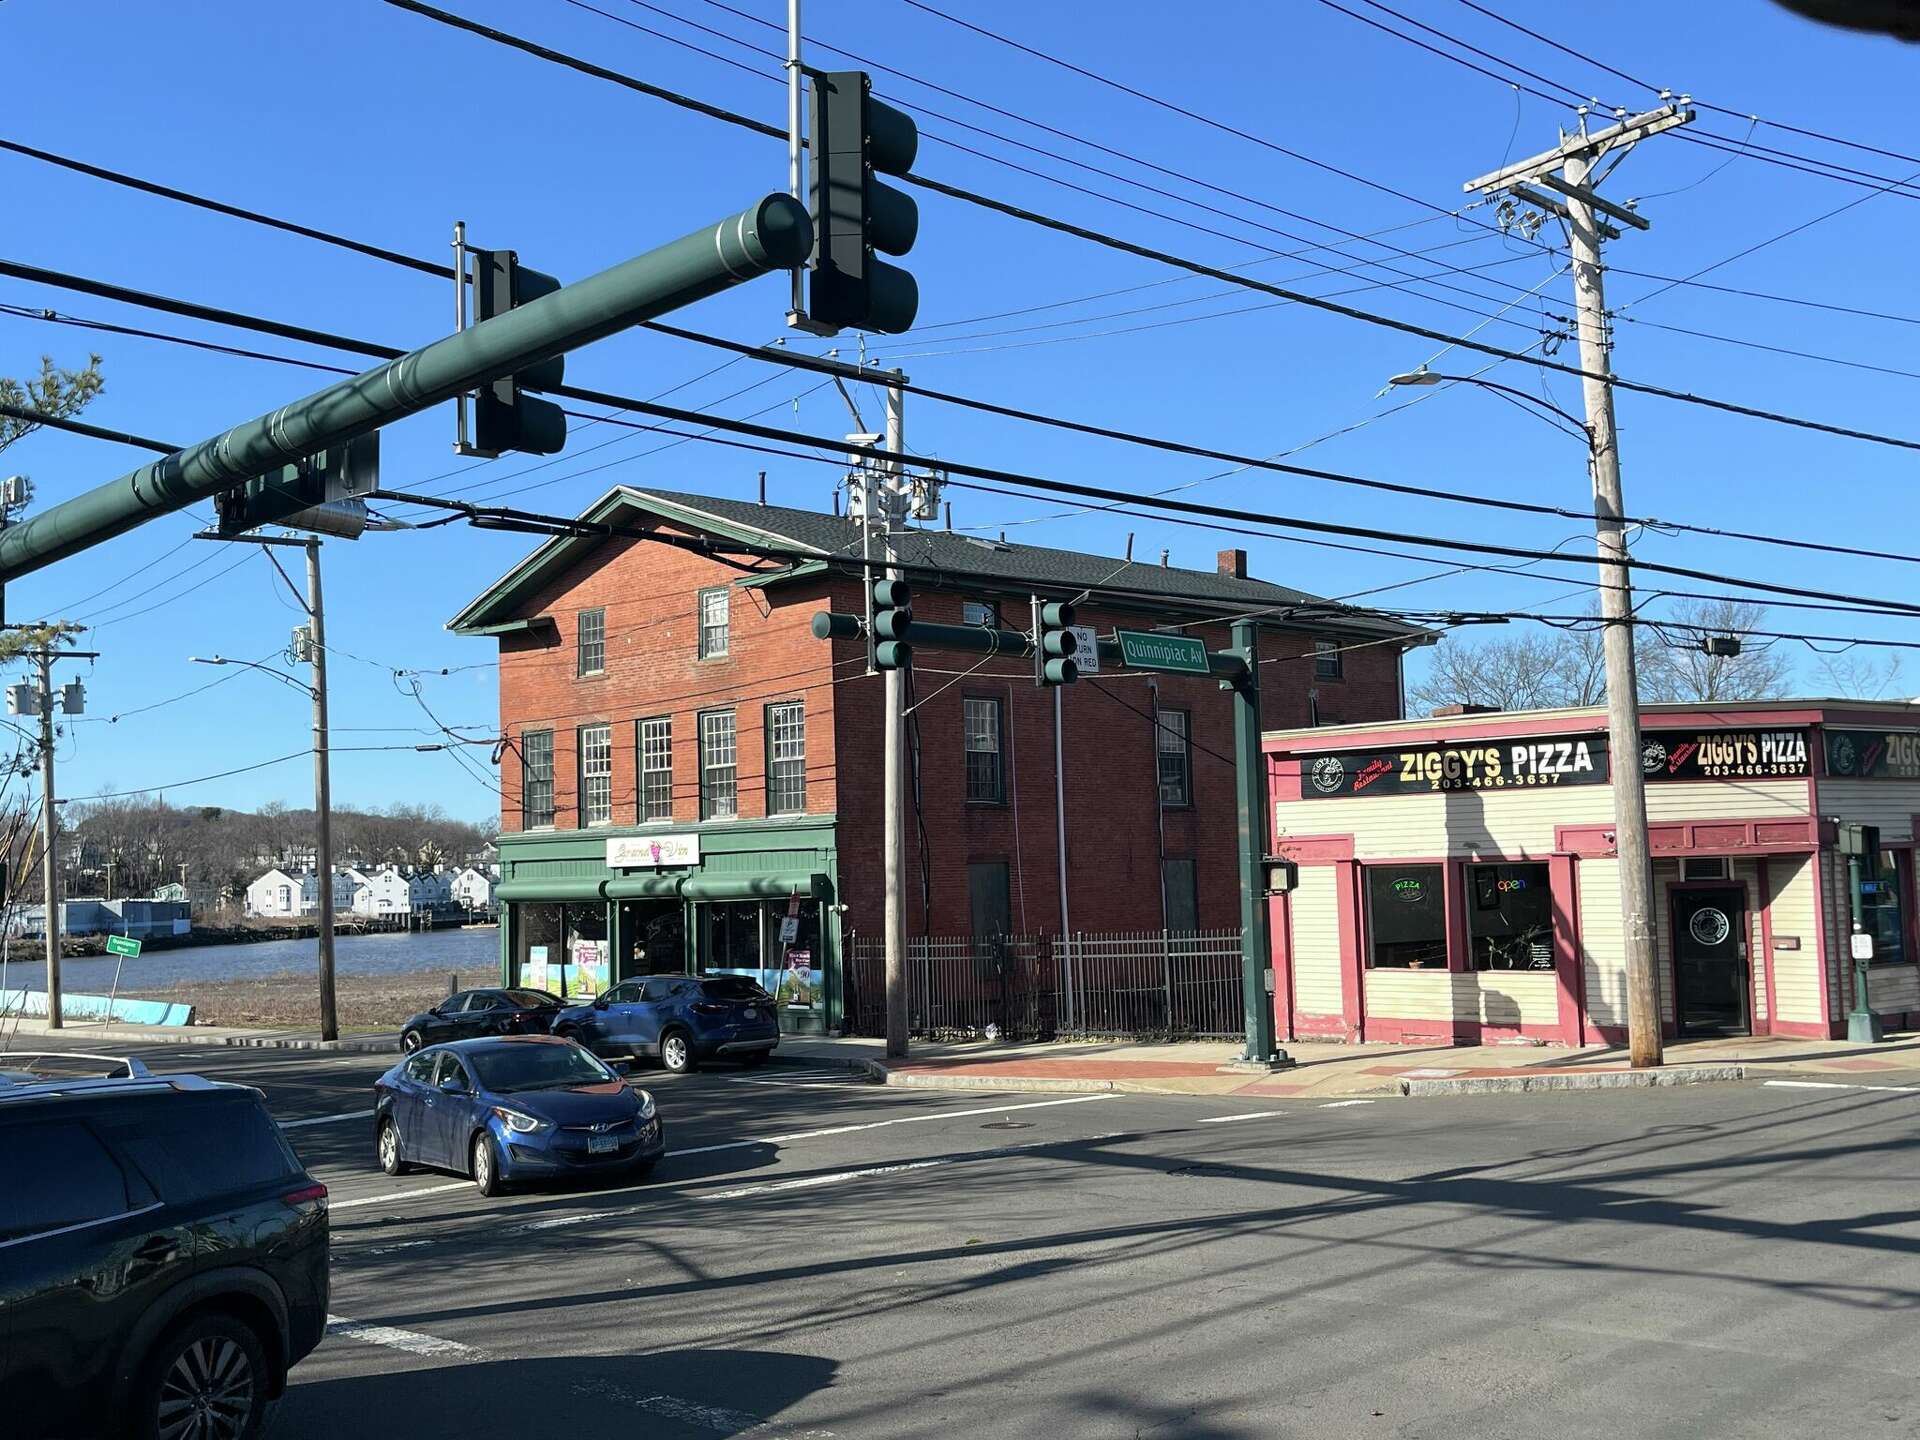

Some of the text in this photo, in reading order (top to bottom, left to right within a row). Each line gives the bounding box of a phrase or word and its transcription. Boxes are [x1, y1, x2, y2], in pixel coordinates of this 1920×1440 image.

[1077, 632, 1088, 641] NO
[1127, 640, 1203, 665] Quinnipiac Av
[1084, 657, 1097, 667] RED
[1697, 734, 1758, 766] ZIGGY'S
[1761, 733, 1808, 763] PIZZA
[1400, 741, 1594, 782] ZIGGY'S PIZZA
[1704, 763, 1805, 776] 203-466-3637
[1431, 773, 1560, 790] 203-466-3637
[1497, 879, 1527, 892] open
